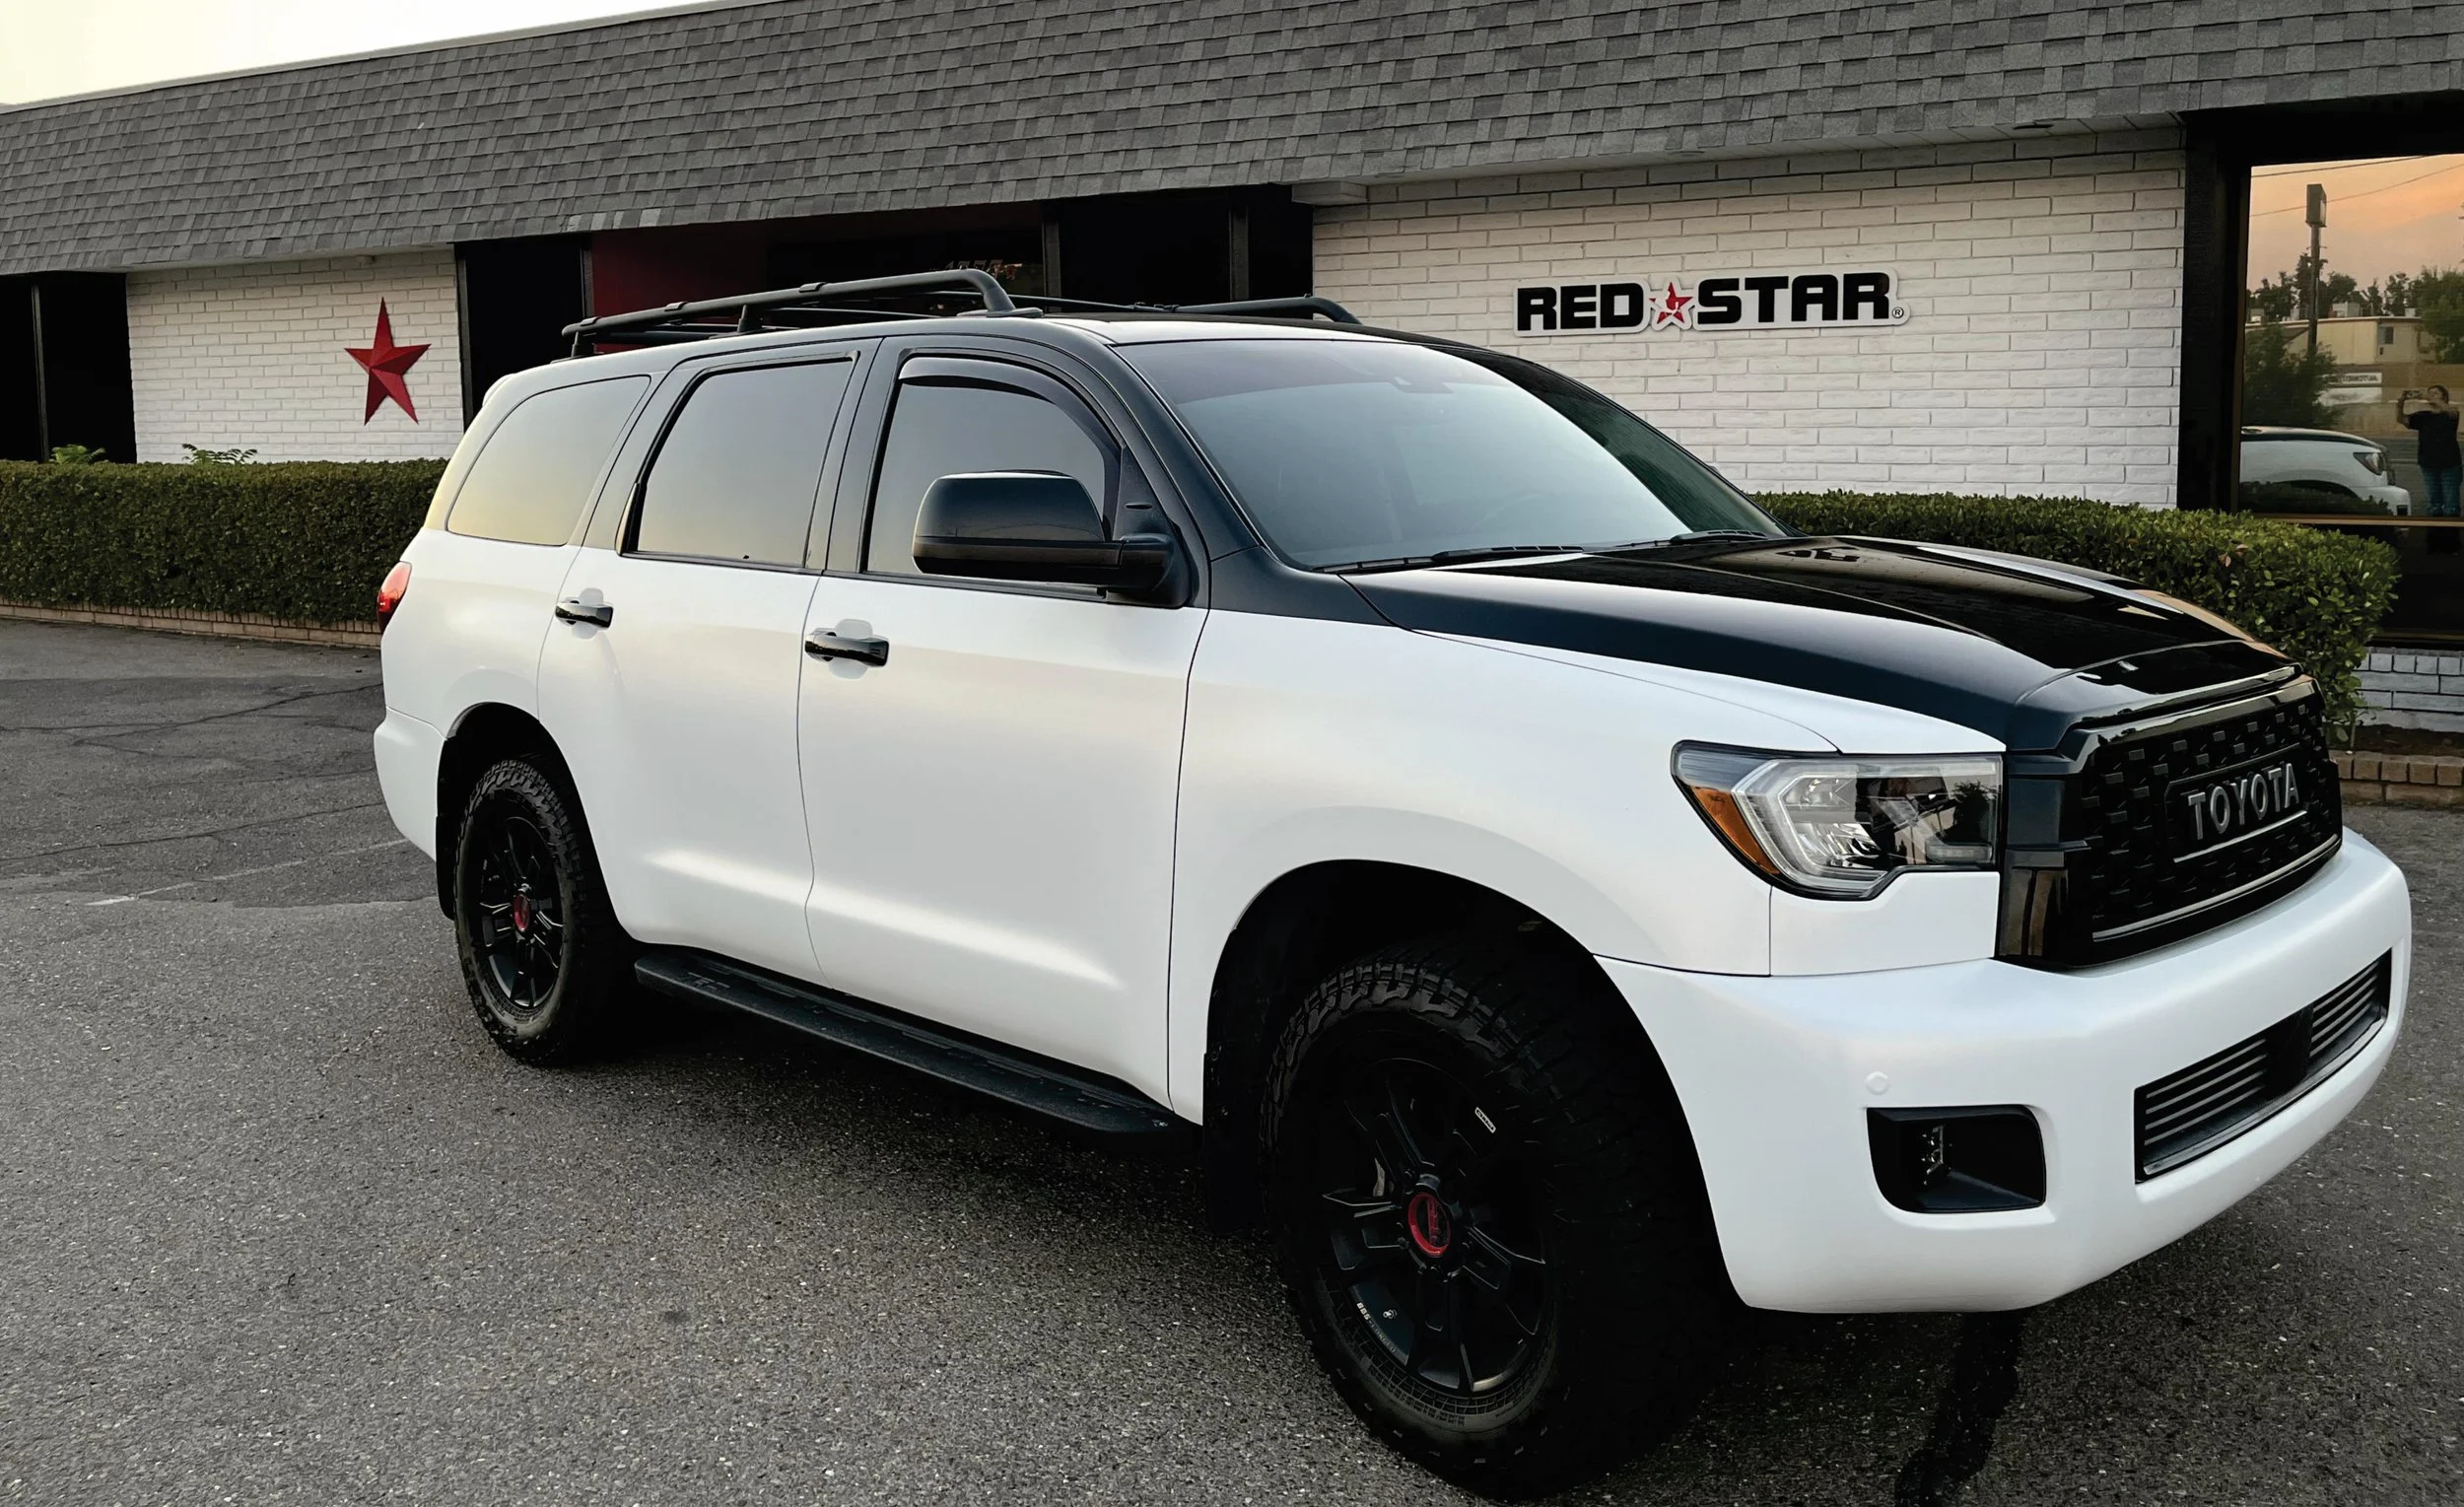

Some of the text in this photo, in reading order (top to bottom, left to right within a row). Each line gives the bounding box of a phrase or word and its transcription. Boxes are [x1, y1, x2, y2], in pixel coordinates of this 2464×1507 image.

[1517, 282, 1644, 330] RED
[1697, 272, 1889, 323] STAR
[2188, 763, 2299, 840] TOYOTA
